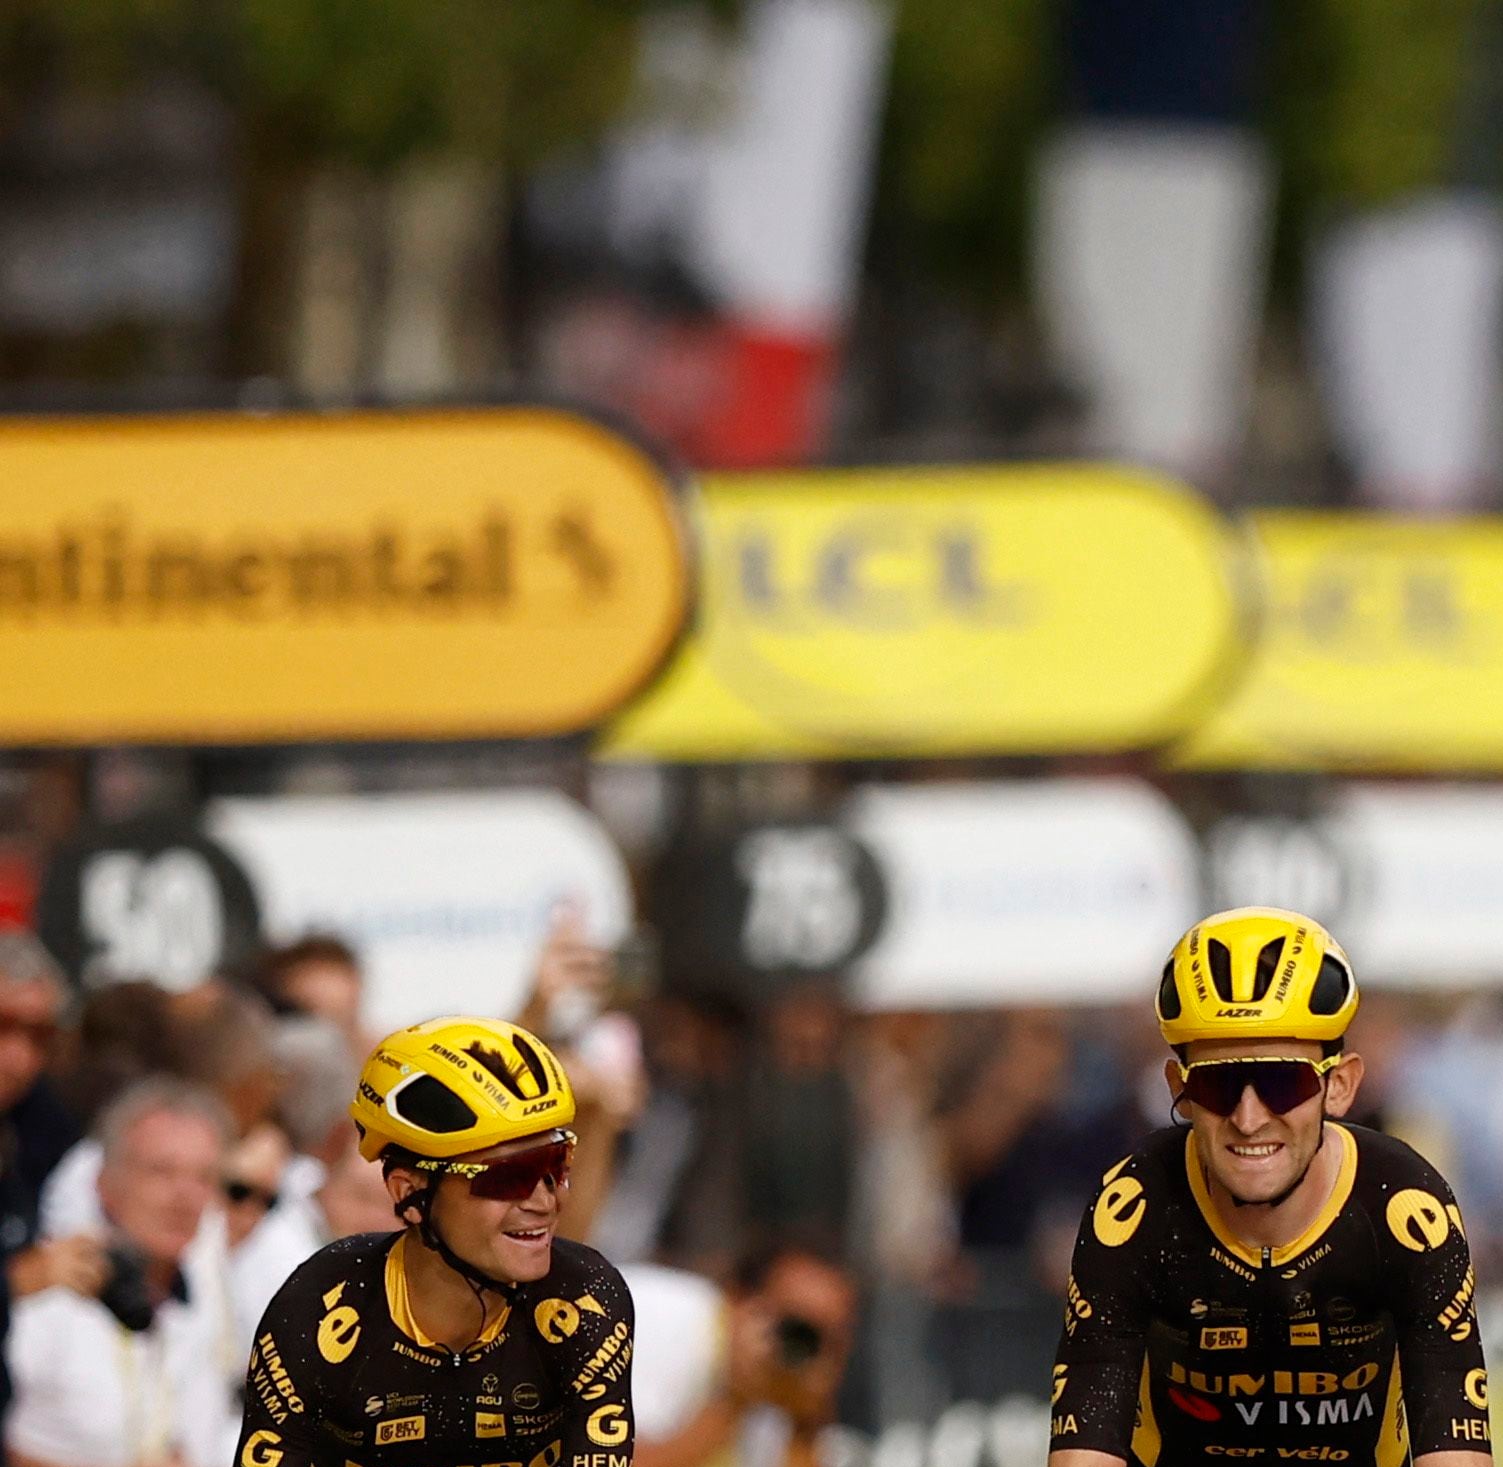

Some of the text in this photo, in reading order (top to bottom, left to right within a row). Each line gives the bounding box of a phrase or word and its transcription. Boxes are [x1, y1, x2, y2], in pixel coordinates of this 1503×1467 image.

[1274, 959, 1297, 1004] JUMBO
[1215, 1007, 1263, 1018] LAZER
[427, 1043, 467, 1070] JUMBO
[483, 1080, 510, 1110] VISMA
[522, 1098, 558, 1117] LAZER
[1210, 1243, 1333, 1282] JUMBO VISMA
[258, 1332, 304, 1414] JUMBO
[392, 1341, 441, 1367] JUMBO
[571, 1321, 628, 1394] JUMBO
[253, 1368, 289, 1425] VISMA
[1167, 1361, 1380, 1397] JUMBO
[476, 1395, 502, 1406] AGU
[1235, 1391, 1374, 1427] VISMA
[586, 1403, 629, 1447] G
